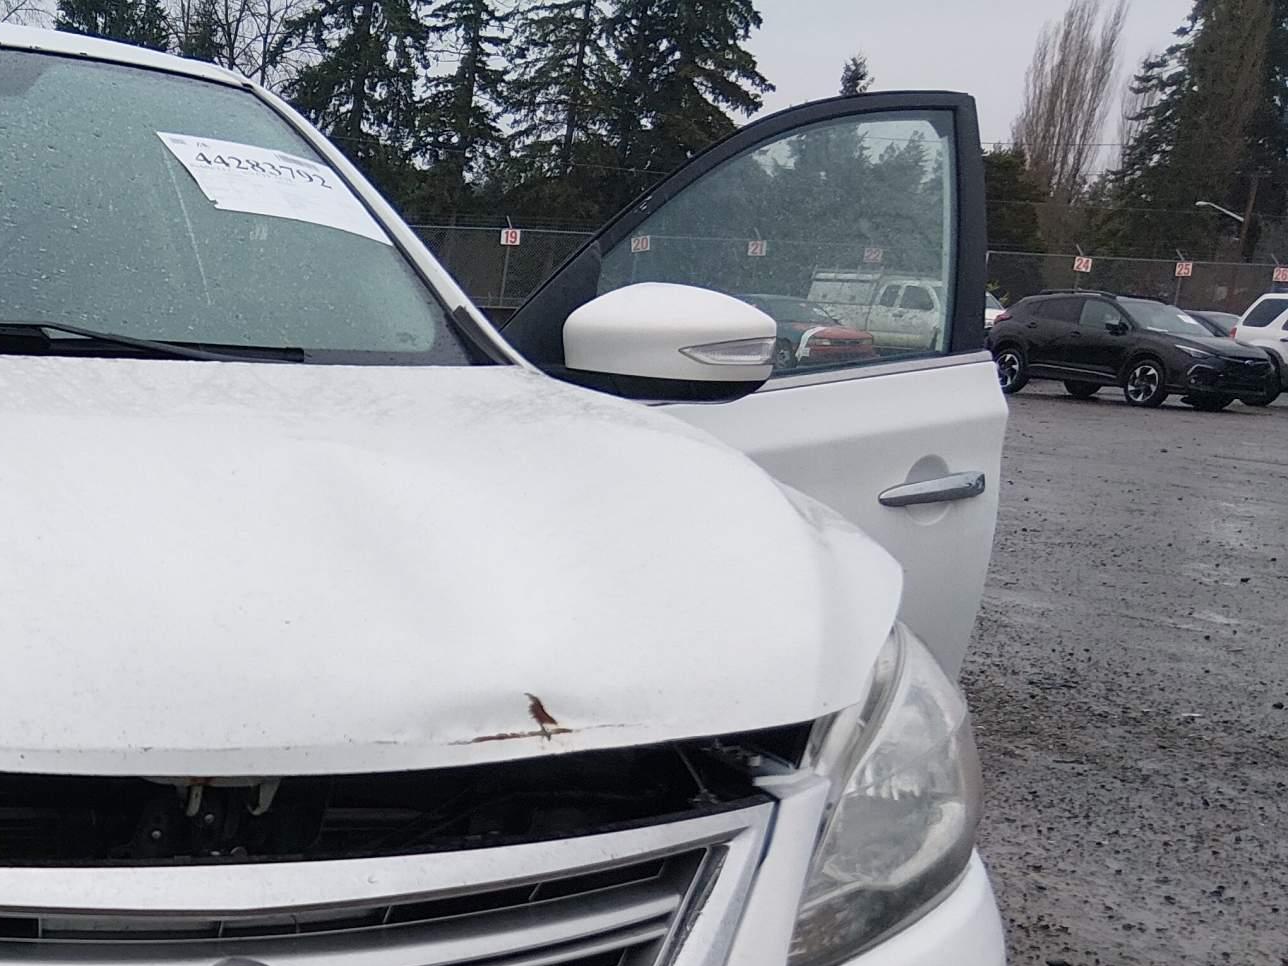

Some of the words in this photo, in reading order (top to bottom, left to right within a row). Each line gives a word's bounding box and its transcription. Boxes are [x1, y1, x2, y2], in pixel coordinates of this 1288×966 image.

[195, 152, 333, 189] 44283792
[504, 230, 518, 244] 19
[633, 237, 649, 251] 20
[750, 243, 765, 255] 21
[866, 248, 881, 261] 22
[1075, 258, 1091, 271] 24
[1176, 263, 1191, 276] 25
